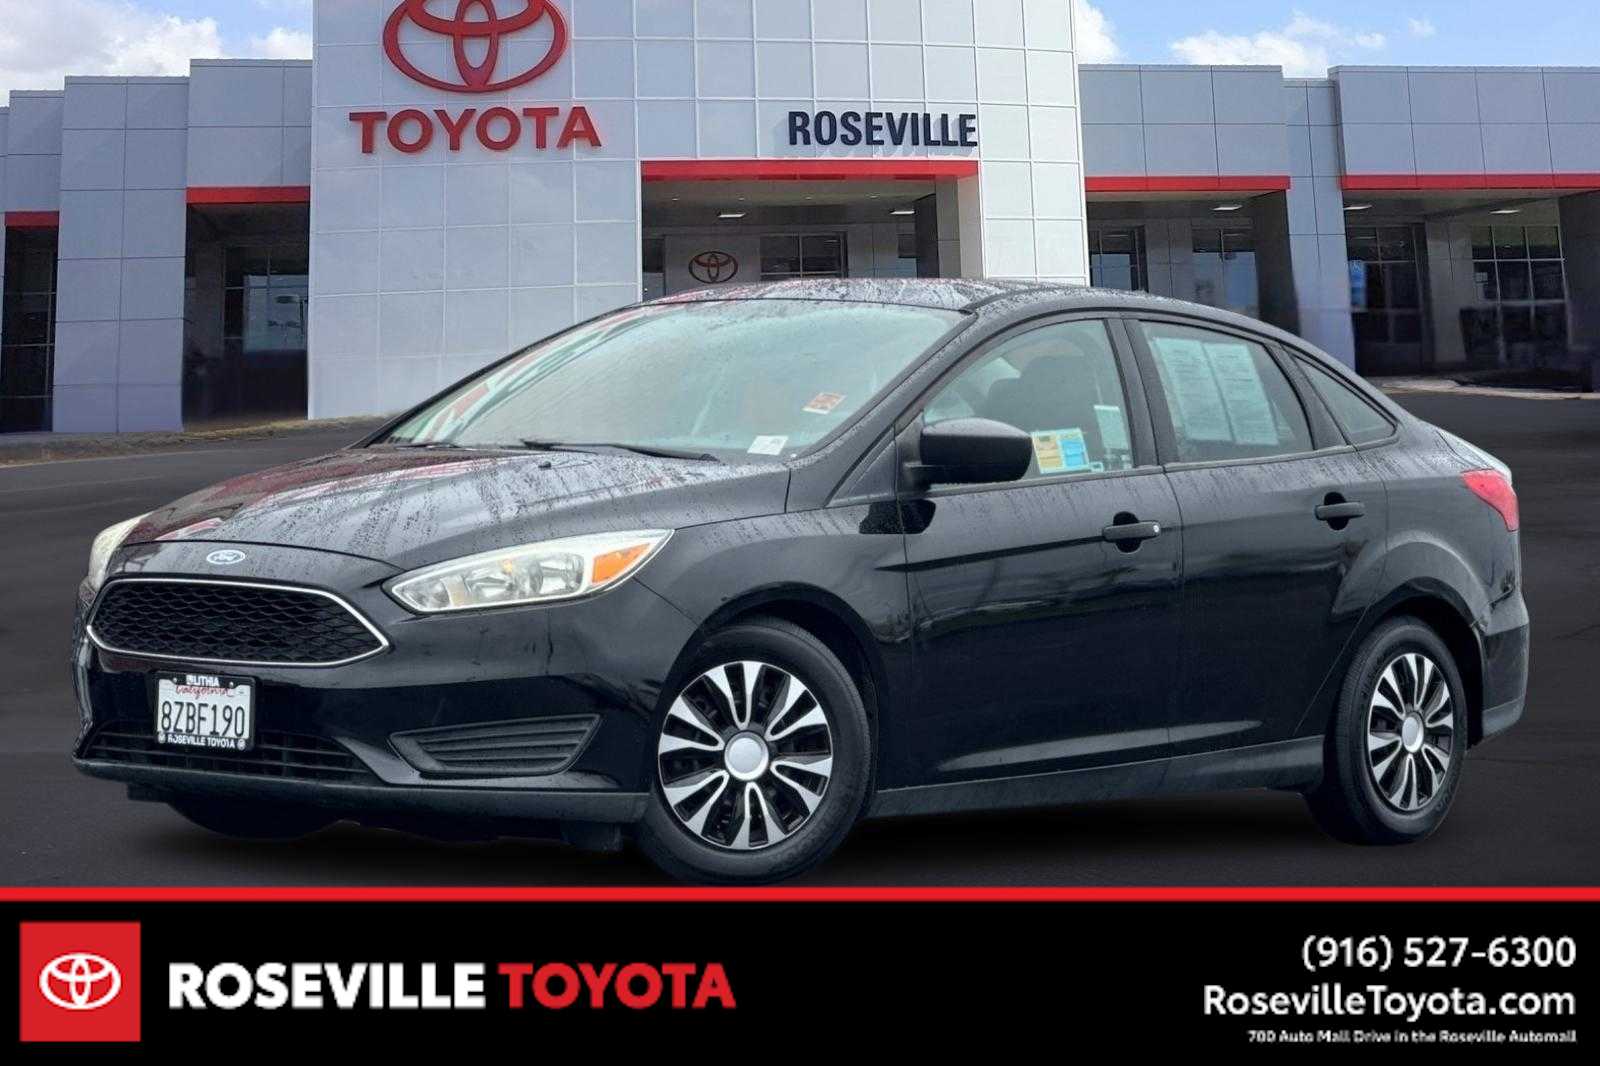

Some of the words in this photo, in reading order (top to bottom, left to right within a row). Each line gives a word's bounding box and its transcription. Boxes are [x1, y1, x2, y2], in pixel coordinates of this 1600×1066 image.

[349, 106, 602, 153] TOYOTA
[788, 110, 978, 147] ROSEVILLE
[161, 701, 246, 738] 8ZBF190
[167, 734, 206, 746] ROSEVILLE
[207, 736, 236, 748] TOYOTA
